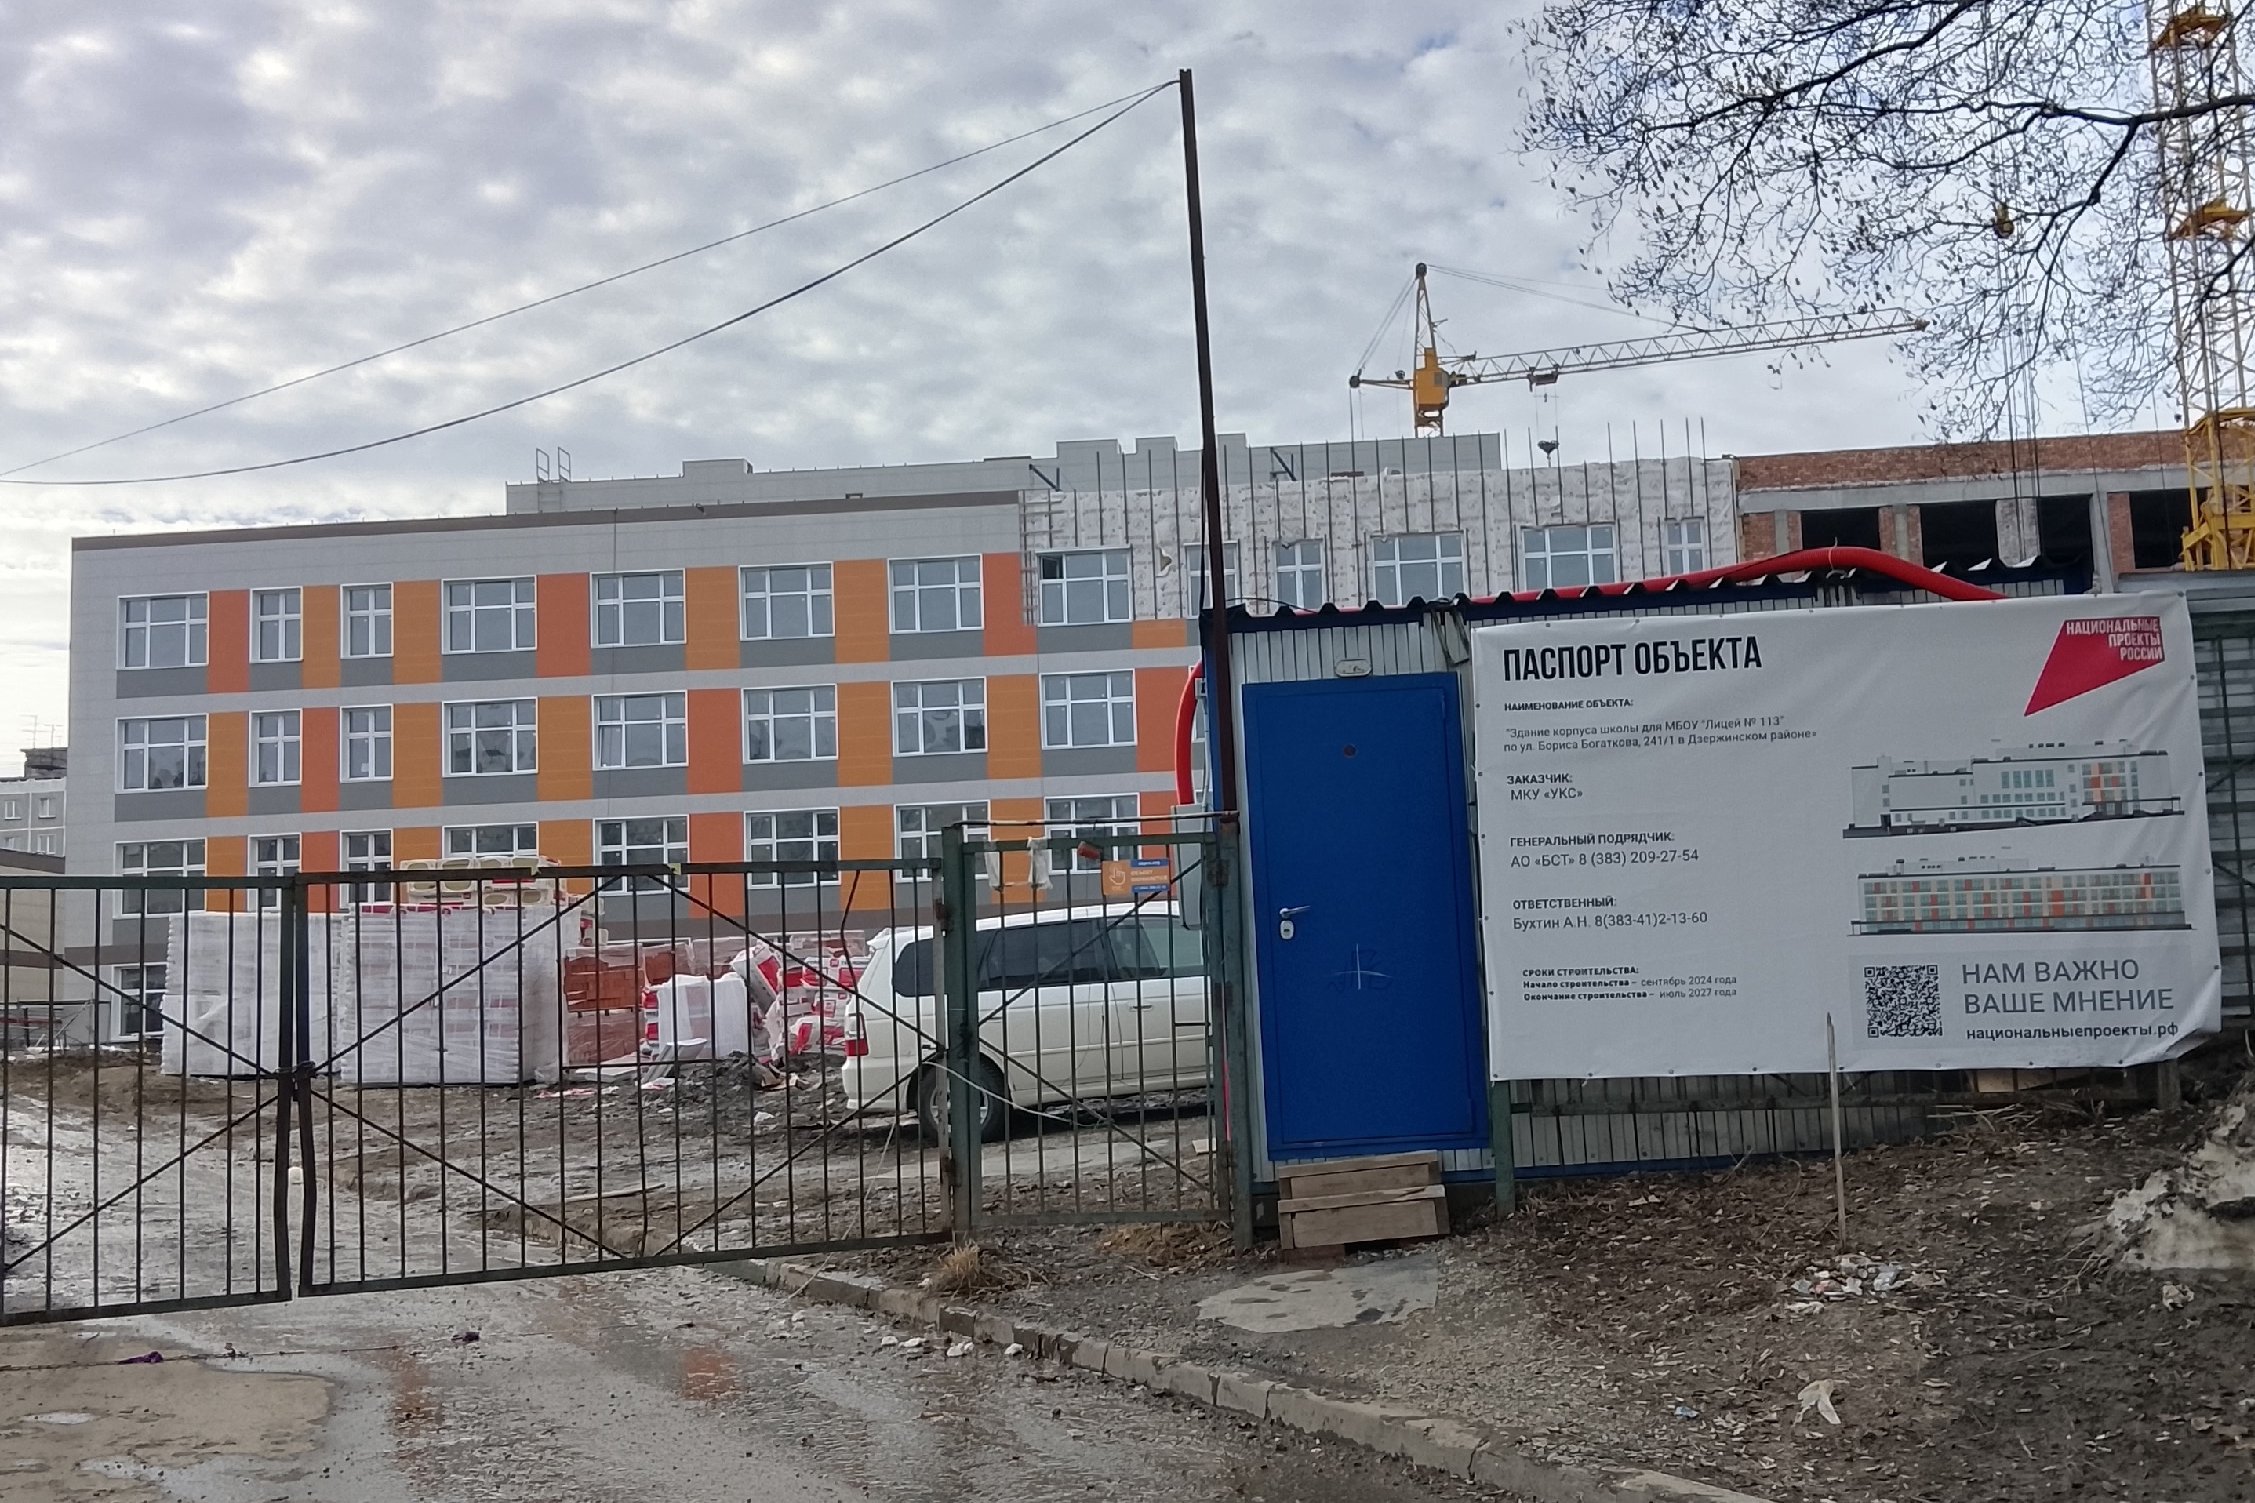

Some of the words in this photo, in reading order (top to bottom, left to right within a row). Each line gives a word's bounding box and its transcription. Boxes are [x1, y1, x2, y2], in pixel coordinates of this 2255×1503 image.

[2066, 618, 2159, 635] НАЦИОНАЛЬНЫЕ
[2108, 633, 2161, 647] ПРОЕКТЫ
[1504, 643, 1626, 681] ПАСПОРТ
[1634, 636, 1762, 674] ОБЪЕКТА
[2119, 646, 2163, 660] РОССИИ
[1504, 700, 1584, 711] НАИМЕНОВАНИЕ
[1586, 699, 1634, 708] ОБЪЕКТА:
[1553, 726, 1598, 737] корпуса
[1600, 724, 1639, 734] школы
[1641, 723, 1662, 734] для
[1665, 720, 1699, 731] МБОУ
[1743, 717, 1757, 728] №
[1503, 742, 1518, 752] по
[1538, 740, 1579, 752] Бориса
[1581, 737, 1642, 749] Богаткова,
[1643, 734, 1674, 747] 241/1
[1678, 736, 1685, 745] в
[1687, 733, 1767, 747] Дзержинском
[1506, 772, 1573, 785] ЗАКАЗЧИК:
[1510, 788, 1540, 801] МКУ
[1543, 786, 1583, 800] «УКС»
[1510, 833, 1595, 847] ГЕНЕРАЛЬНЫЙ
[1598, 831, 1676, 845] ПОДРЯДЧИК:
[1511, 855, 1530, 867] АО
[1534, 853, 1575, 867] «БСТ»
[1578, 852, 1587, 865] 8
[1590, 850, 1627, 868] (383)
[1630, 848, 1699, 864] 209-27-54
[1512, 895, 1617, 910] ОТВЕТСТВЕННЫЙ:
[1513, 917, 1560, 932] Бухтин
[1594, 911, 1708, 930] 8(383-41)2-13-60
[1522, 968, 1555, 977] СРОКИ
[1556, 966, 1640, 977] СТРОИТЕЛЬСТВА:
[1962, 962, 2026, 984] НАМ
[2034, 958, 2139, 983] ВАЖНО
[1523, 981, 1559, 989] Начало
[1560, 979, 1630, 990] строительства
[1641, 977, 1686, 988] сентябрь
[1688, 975, 1712, 986] 2024
[1714, 976, 1737, 986] года
[1523, 993, 1577, 1002] Окончание
[1577, 991, 1648, 1002] строительства
[1659, 990, 1686, 999] июль
[1688, 988, 1712, 998] 2027
[1714, 989, 1737, 998] года
[1964, 992, 2046, 1015] ВАШЕ
[2052, 987, 2175, 1013] МНЕНИЕ
[1966, 1021, 2179, 1042] национальныепроекты.рф
